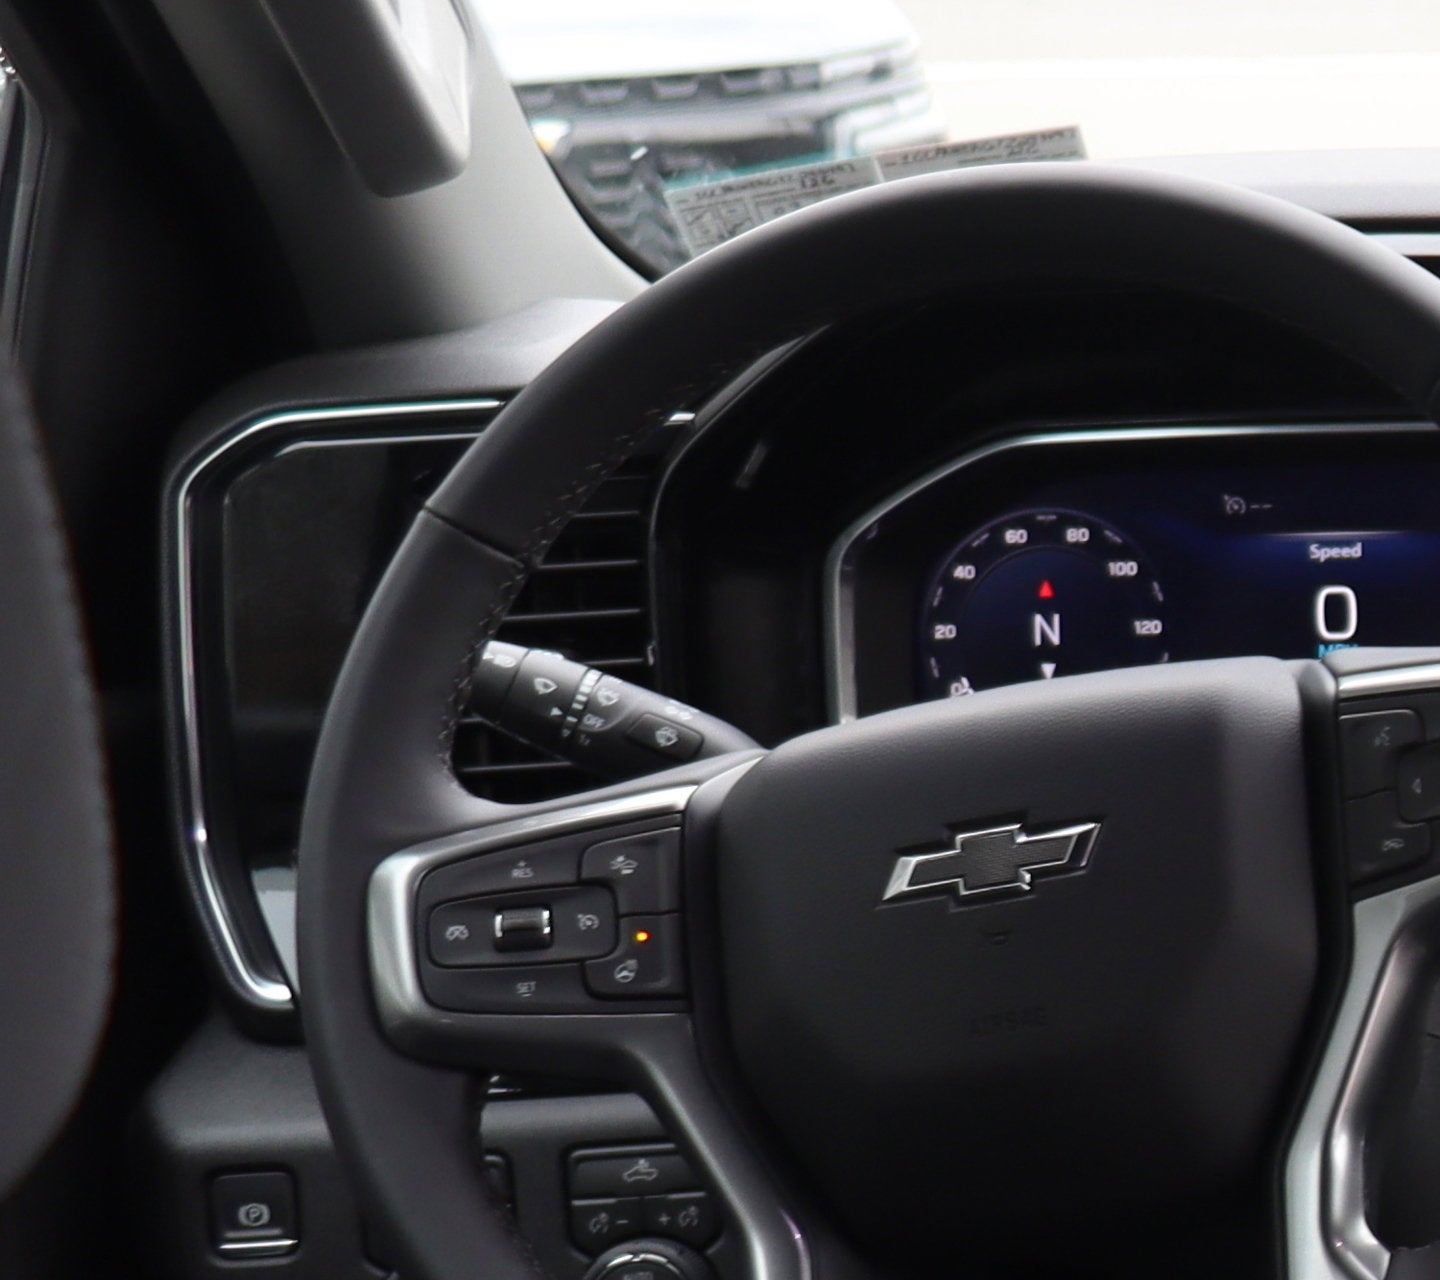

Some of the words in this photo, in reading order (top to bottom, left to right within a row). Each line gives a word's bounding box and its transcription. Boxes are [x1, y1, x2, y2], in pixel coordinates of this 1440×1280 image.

[1005, 529, 1027, 544] 60
[1066, 528, 1089, 543] 80
[1310, 542, 1362, 562] Speed
[953, 565, 976, 580] 40
[1108, 561, 1138, 576] 100
[1315, 585, 1358, 640] 0
[935, 624, 957, 639] 20
[1034, 614, 1061, 646] N
[1134, 620, 1163, 634] 120
[511, 867, 534, 879] RES
[516, 981, 536, 994] SET
